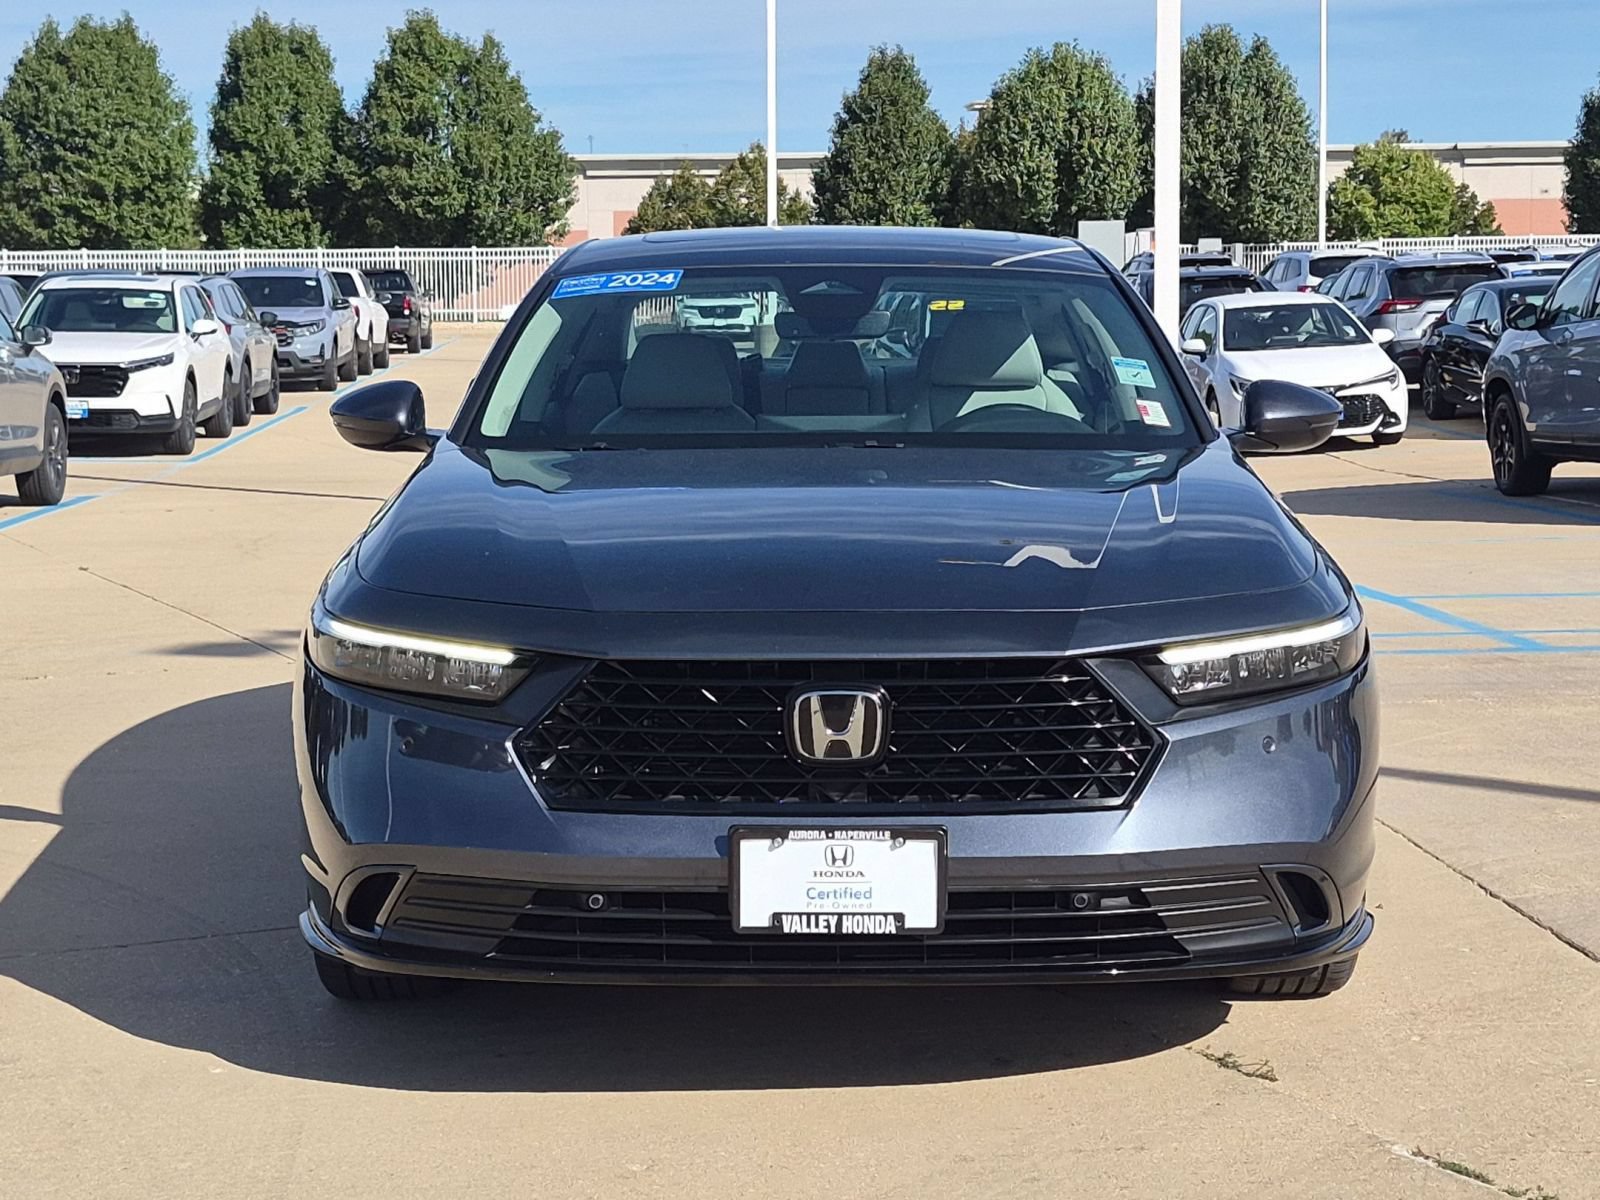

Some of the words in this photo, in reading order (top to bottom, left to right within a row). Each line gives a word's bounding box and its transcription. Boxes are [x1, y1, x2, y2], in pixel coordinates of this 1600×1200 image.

[607, 273, 675, 288] 2024
[788, 830, 827, 841] AURORA
[834, 830, 891, 841] NAPERVILLE
[813, 870, 865, 878] HONDA
[806, 887, 872, 900] Certified
[781, 914, 839, 934] VALLEY
[842, 914, 897, 934] HONDA
